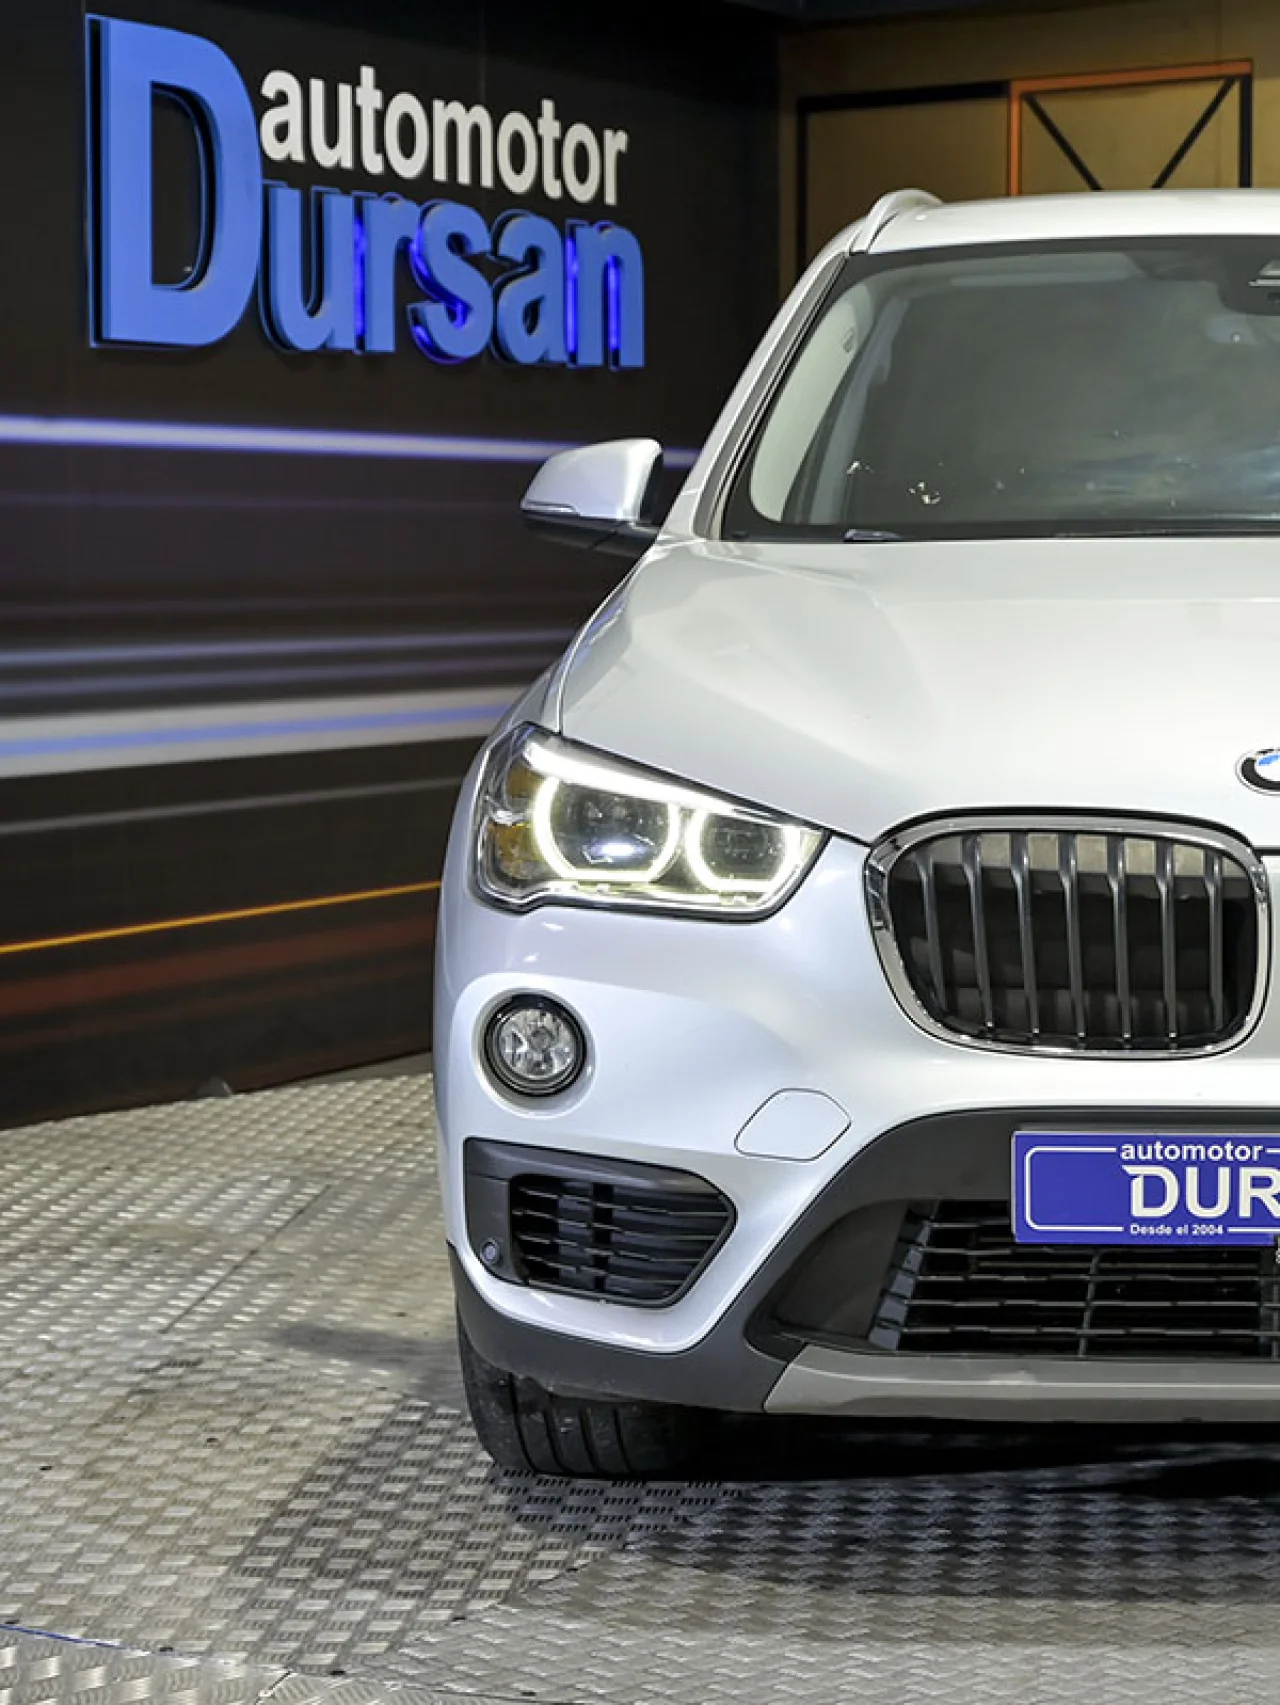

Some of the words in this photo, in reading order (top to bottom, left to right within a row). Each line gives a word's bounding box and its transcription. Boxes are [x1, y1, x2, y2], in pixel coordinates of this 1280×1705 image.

[85, 13, 645, 370] Dursan
[260, 66, 628, 206] automotor
[1121, 1141, 1263, 1160] automotor
